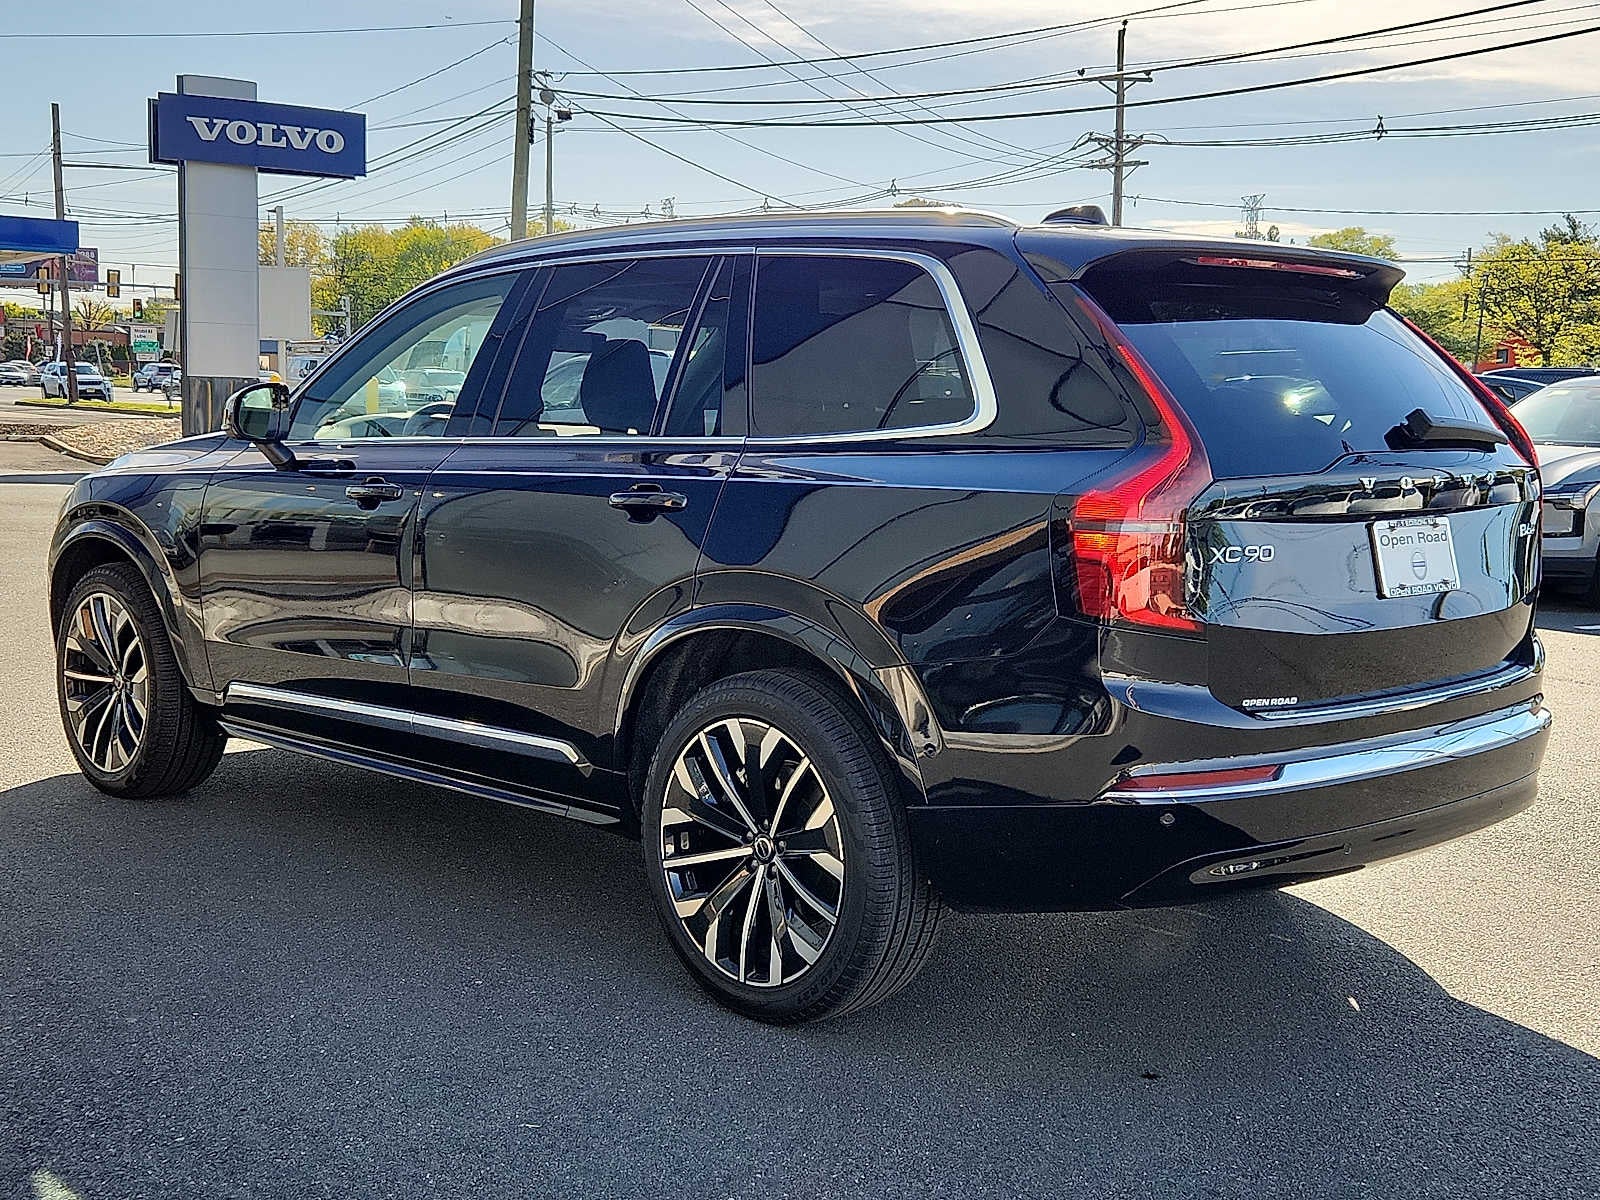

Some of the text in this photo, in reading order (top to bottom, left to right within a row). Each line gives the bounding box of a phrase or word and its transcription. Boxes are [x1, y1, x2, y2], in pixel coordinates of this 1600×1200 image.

[186, 115, 345, 154] VOLVO
[1360, 471, 1495, 489] VOLVO
[1380, 530, 1448, 549] Open Road
[1209, 545, 1275, 564] XC90
[1390, 582, 1458, 597] OPEN ROAD VOLVO
[1242, 696, 1298, 707] OPEN ROAD
